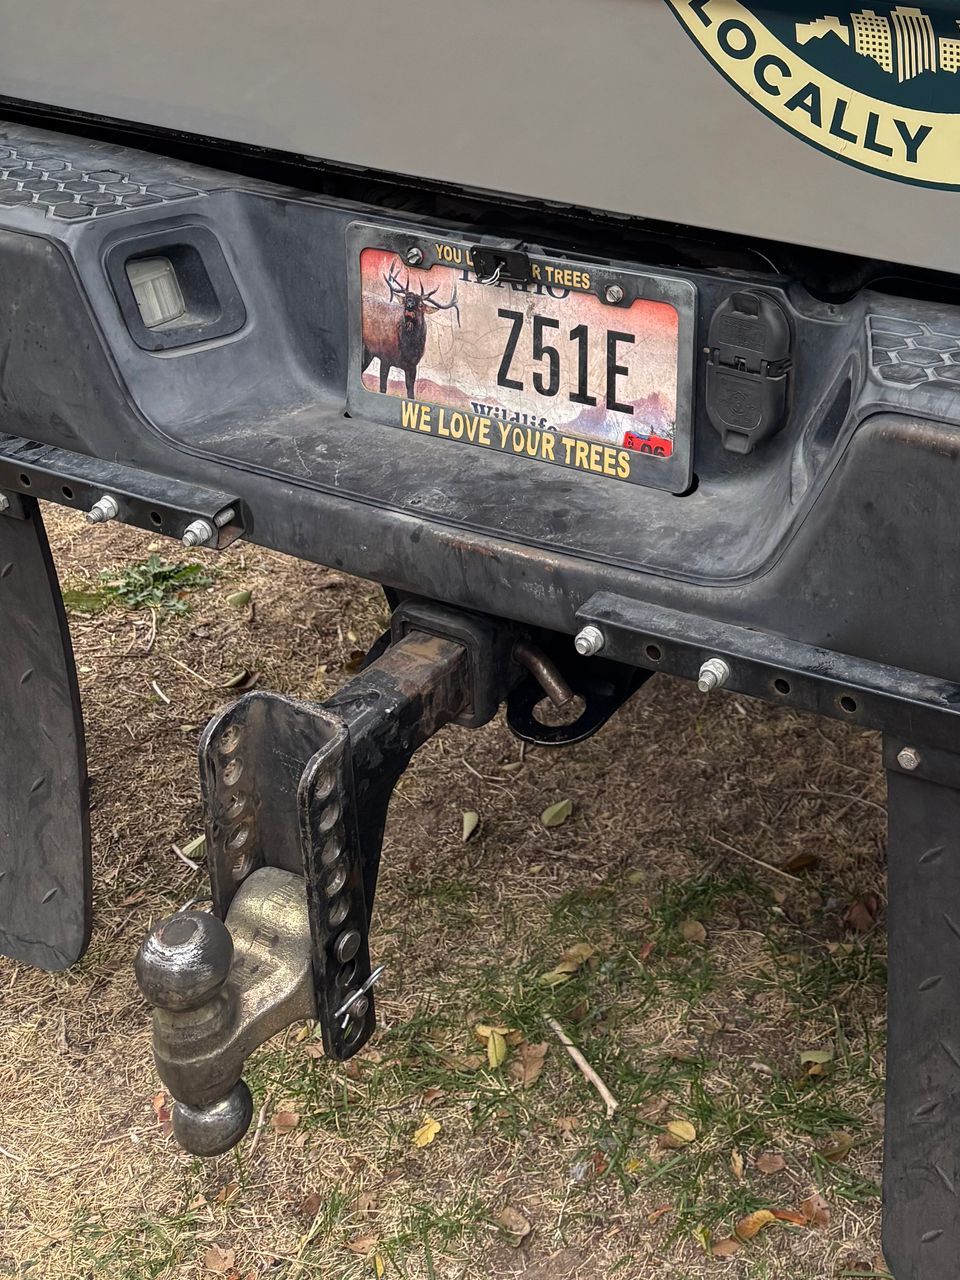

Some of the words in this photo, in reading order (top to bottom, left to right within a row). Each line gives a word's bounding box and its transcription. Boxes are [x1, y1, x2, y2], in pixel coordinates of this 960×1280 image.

[434, 243, 462, 264] YOU
[545, 265, 591, 290] TREES
[496, 307, 637, 416] Z51E
[400, 400, 432, 433] WE
[437, 408, 492, 446] LOVE
[497, 421, 556, 462] YOUR
[561, 436, 631, 479] TREES
